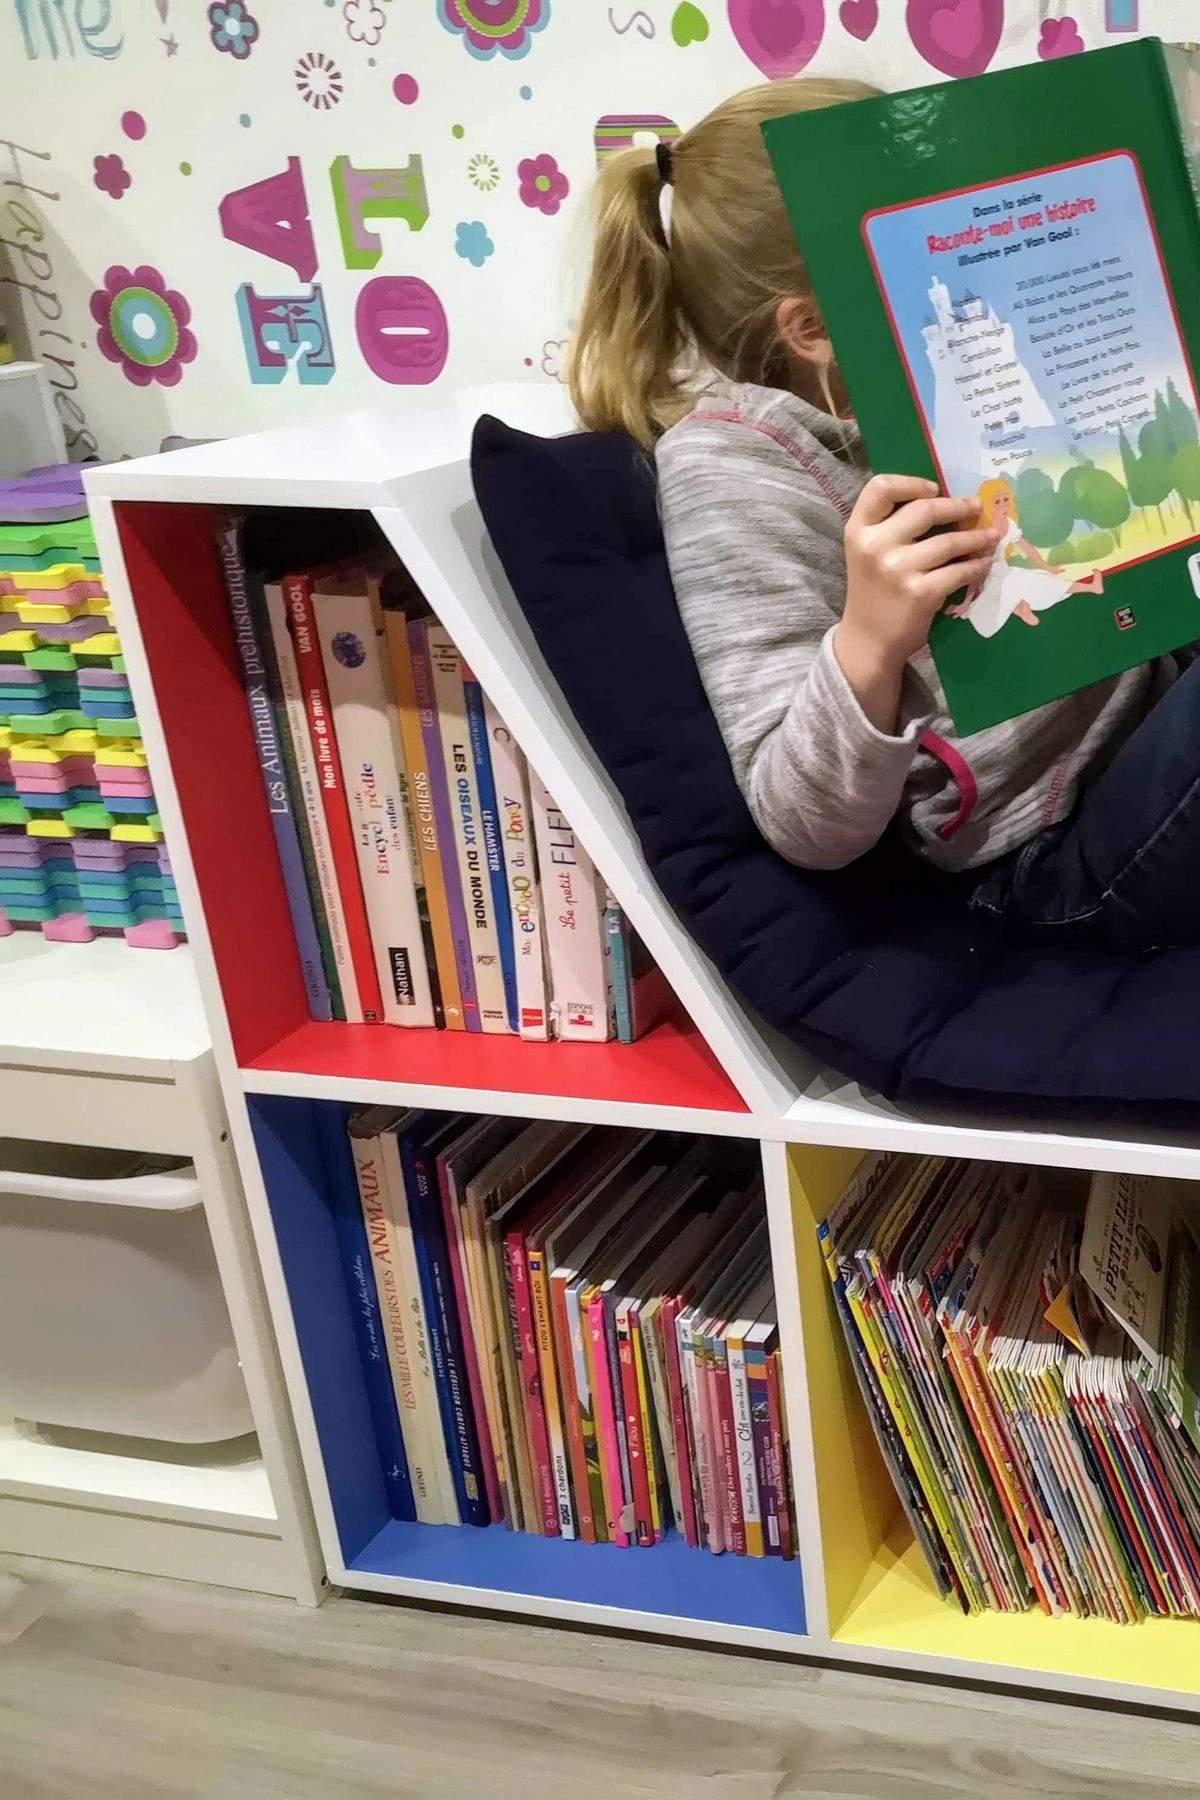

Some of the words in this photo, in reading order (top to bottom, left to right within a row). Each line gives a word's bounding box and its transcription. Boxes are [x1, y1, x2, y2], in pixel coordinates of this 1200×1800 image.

[973, 204, 1000, 218] Dans
[1002, 199, 1014, 209] la
[1016, 192, 1042, 207] série
[1018, 212, 1043, 230] une
[1045, 198, 1095, 222] histoire
[1003, 243, 1022, 256] par
[1023, 237, 1045, 249] Van
[1048, 226, 1072, 242] Gool
[289, 584, 307, 622] GOOL
[298, 627, 312, 653] VAN
[311, 689, 323, 717] mots
[251, 685, 279, 773] Animaux
[314, 720, 326, 734] de
[319, 738, 331, 762] livre
[452, 744, 467, 773] LES
[324, 765, 336, 789] Mon
[269, 781, 289, 813] Les
[414, 772, 432, 822] CHIENS
[457, 778, 476, 845] OISEAUX
[482, 810, 493, 821] LE
[422, 827, 437, 851] LES
[484, 822, 500, 871] HAMSTER
[467, 850, 480, 871] DU
[470, 876, 487, 928] MONDE
[558, 873, 578, 906] petit
[558, 910, 576, 930] Le
[397, 953, 410, 998] Nathan
[361, 1161, 391, 1264] ANIMAUX
[384, 1270, 396, 1292] DES
[533, 1280, 541, 1294] ROI
[388, 1295, 407, 1355] COULEURS
[398, 1359, 411, 1387] MILLE
[447, 1358, 455, 1367] LE
[404, 1391, 416, 1410] LES
[628, 1426, 638, 1447] Filou
[556, 1455, 566, 1492] chardons
